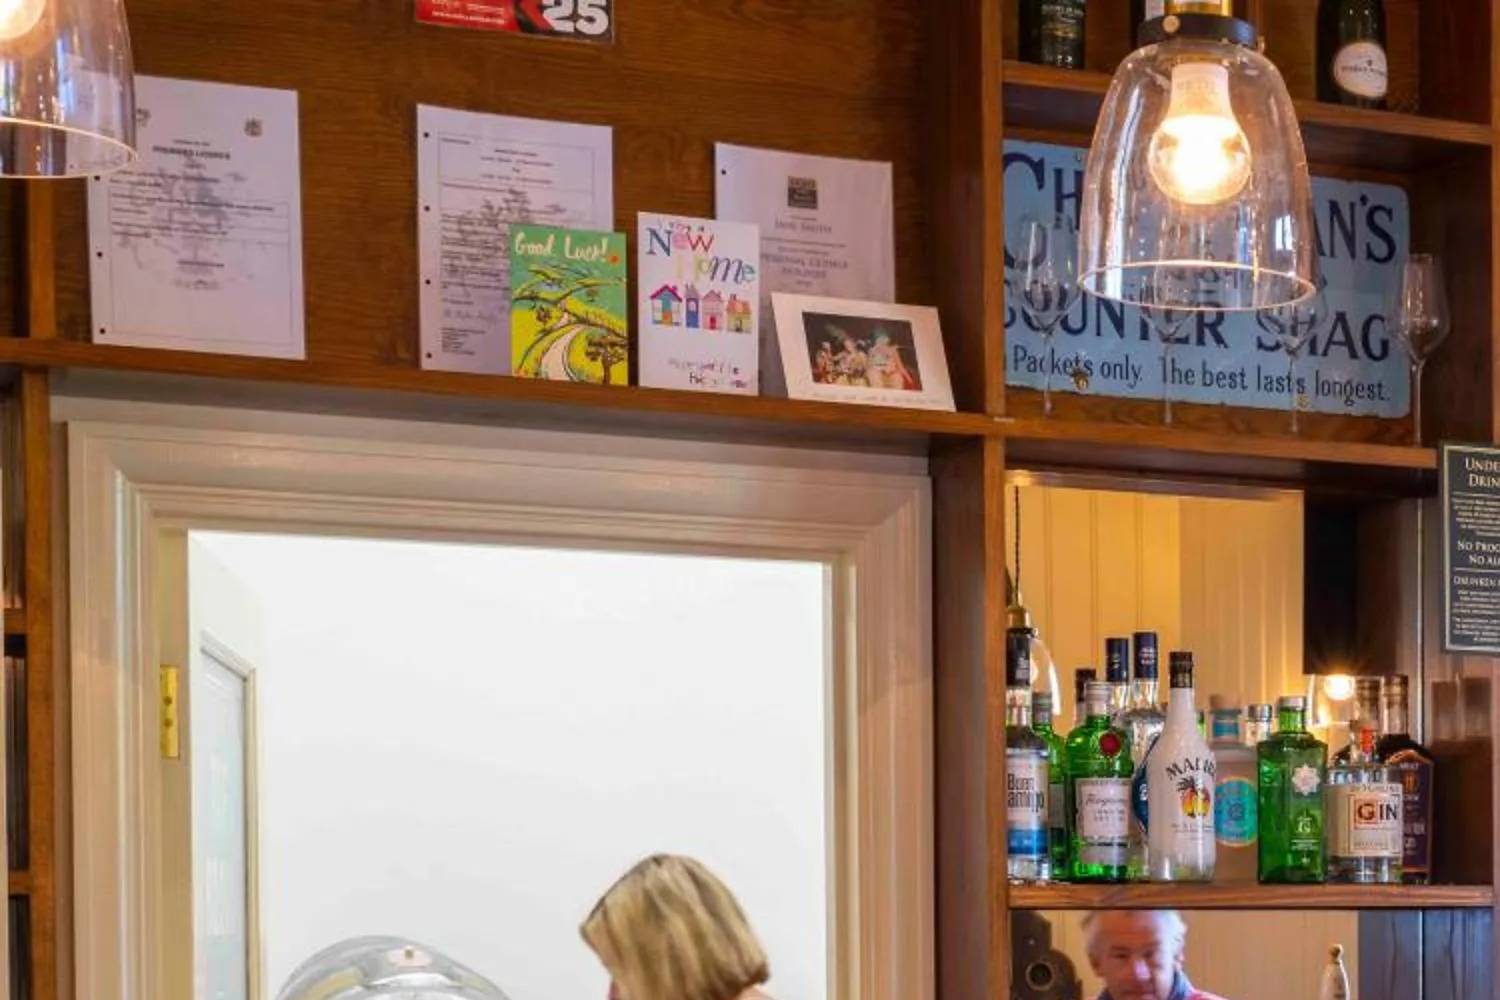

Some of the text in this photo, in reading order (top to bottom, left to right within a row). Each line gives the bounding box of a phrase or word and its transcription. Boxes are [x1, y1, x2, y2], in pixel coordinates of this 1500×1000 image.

[543, 0, 610, 35] 25
[514, 231, 609, 263] Good Luck!
[1255, 304, 1391, 362] SHAG
[1013, 344, 1392, 407] Packets only. The best lasts longest.
[1357, 802, 1398, 821] GIN
